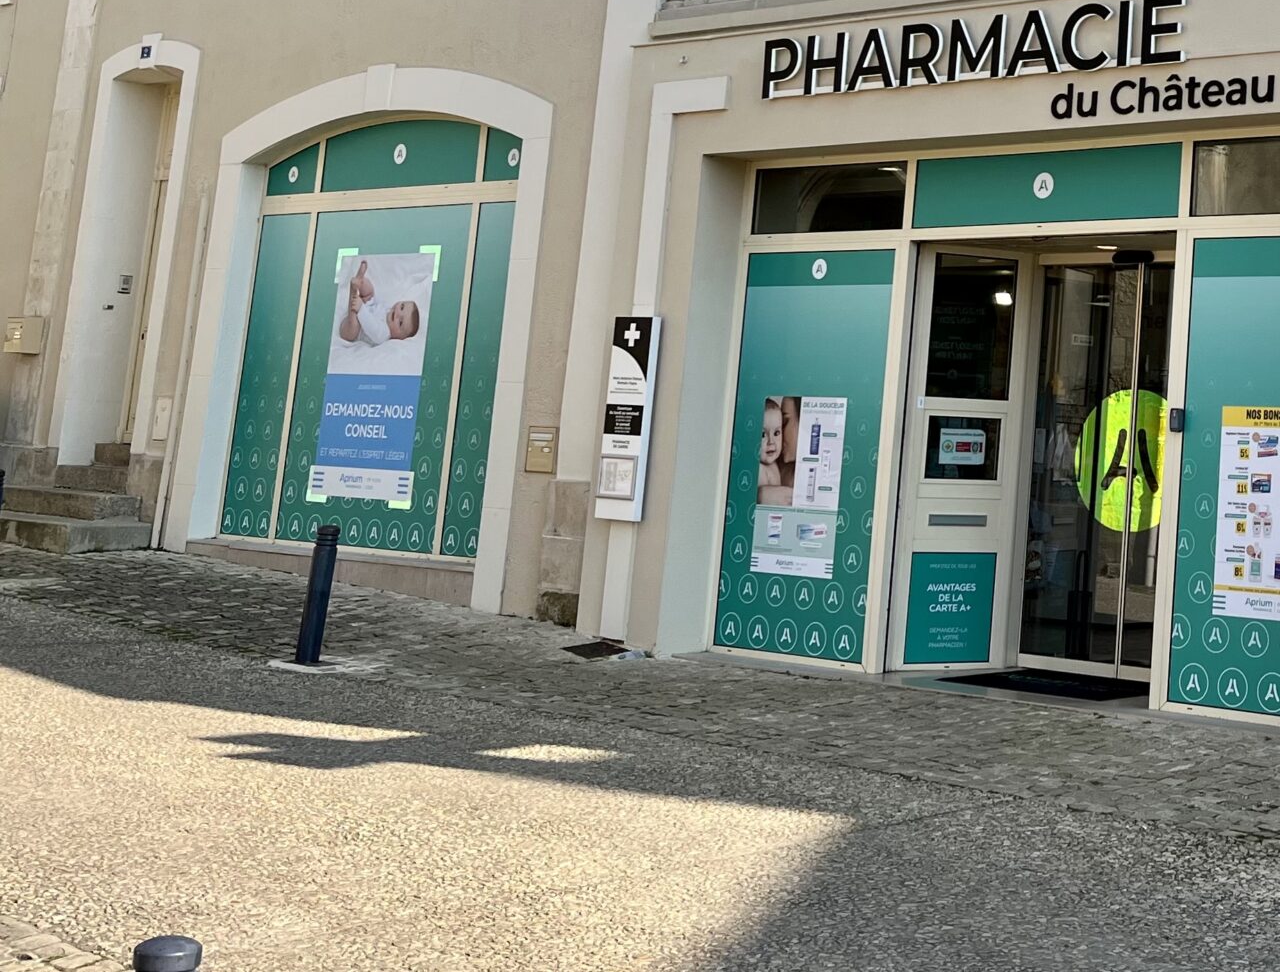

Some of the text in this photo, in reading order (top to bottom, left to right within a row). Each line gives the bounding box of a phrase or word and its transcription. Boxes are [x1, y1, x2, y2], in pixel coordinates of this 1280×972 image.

[1050, 73, 1276, 120] du Château
[325, 402, 414, 419] DEMANDEZ-NOUS
[1246, 409, 1262, 420] NOS
[344, 424, 388, 439] CONSEIL
[320, 447, 328, 456] ET
[328, 448, 358, 458] REPARTEZ
[359, 449, 385, 459] L'ESPRIT
[339, 473, 363, 484] Aprium
[775, 559, 794, 567] Aprium
[927, 583, 977, 592] AVANTAGES
[938, 593, 964, 602] DE LA
[1245, 597, 1273, 607] Aprium
[928, 604, 971, 612] CARTE A+
